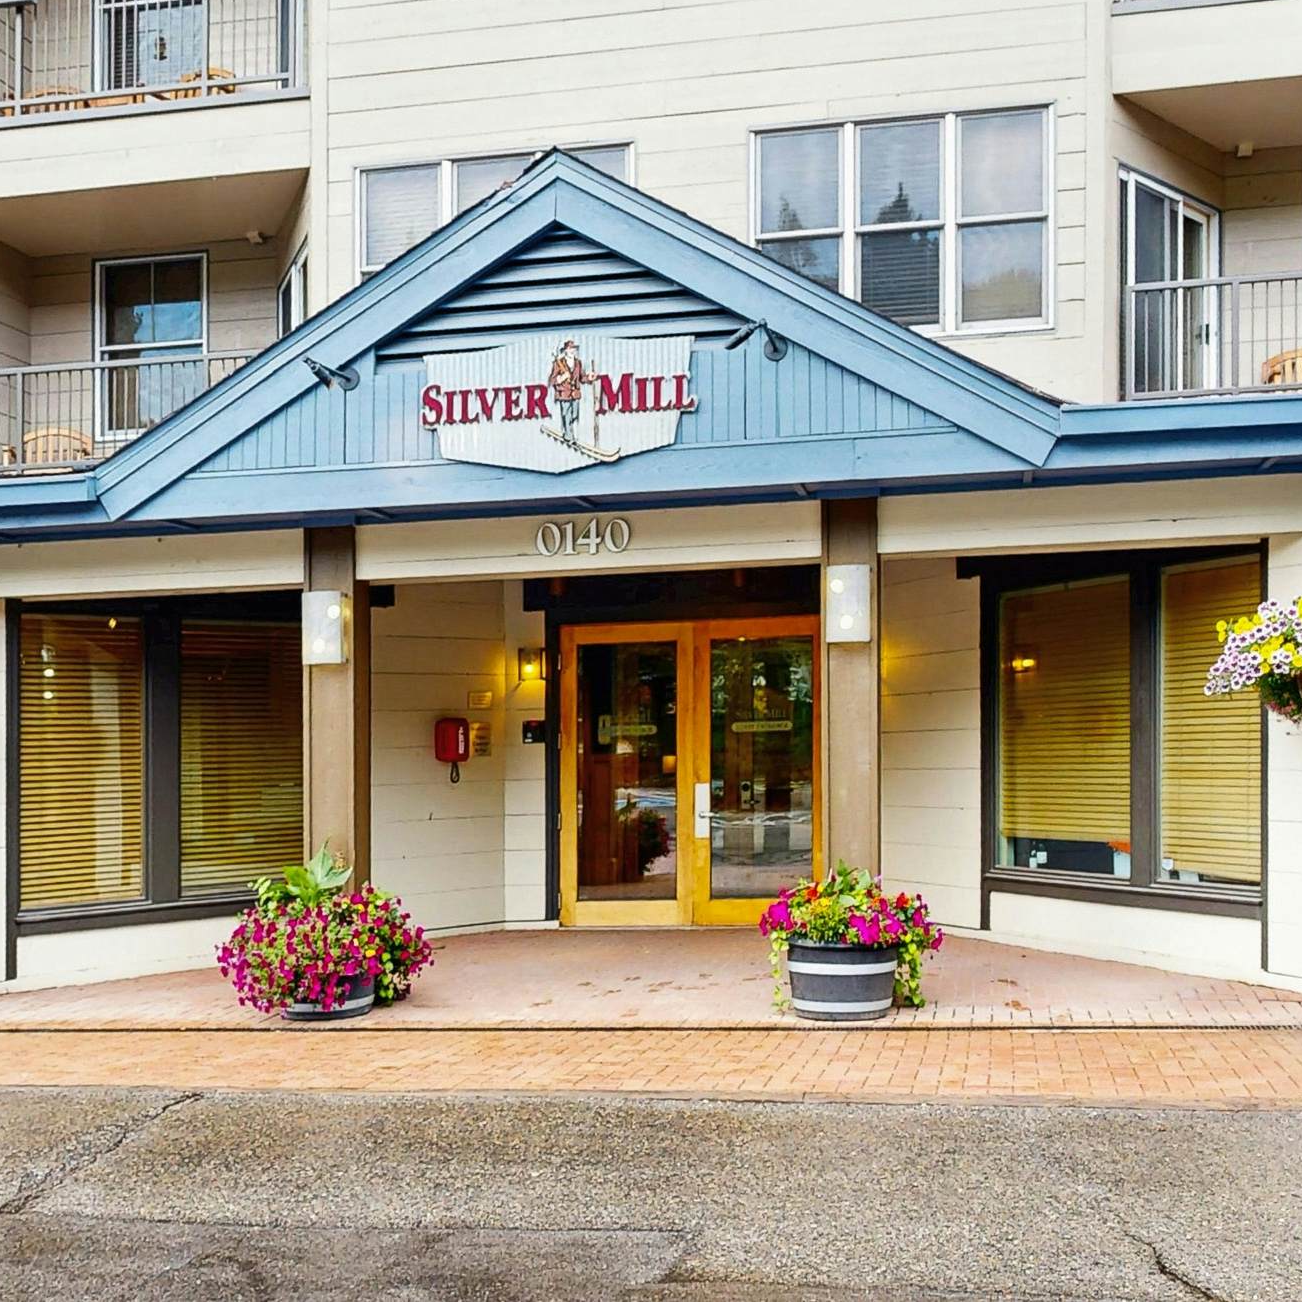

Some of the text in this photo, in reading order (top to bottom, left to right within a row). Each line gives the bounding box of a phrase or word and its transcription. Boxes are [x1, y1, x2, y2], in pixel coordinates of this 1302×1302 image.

[421, 372, 696, 427] SILVER MILL
[536, 517, 630, 557] 0140
